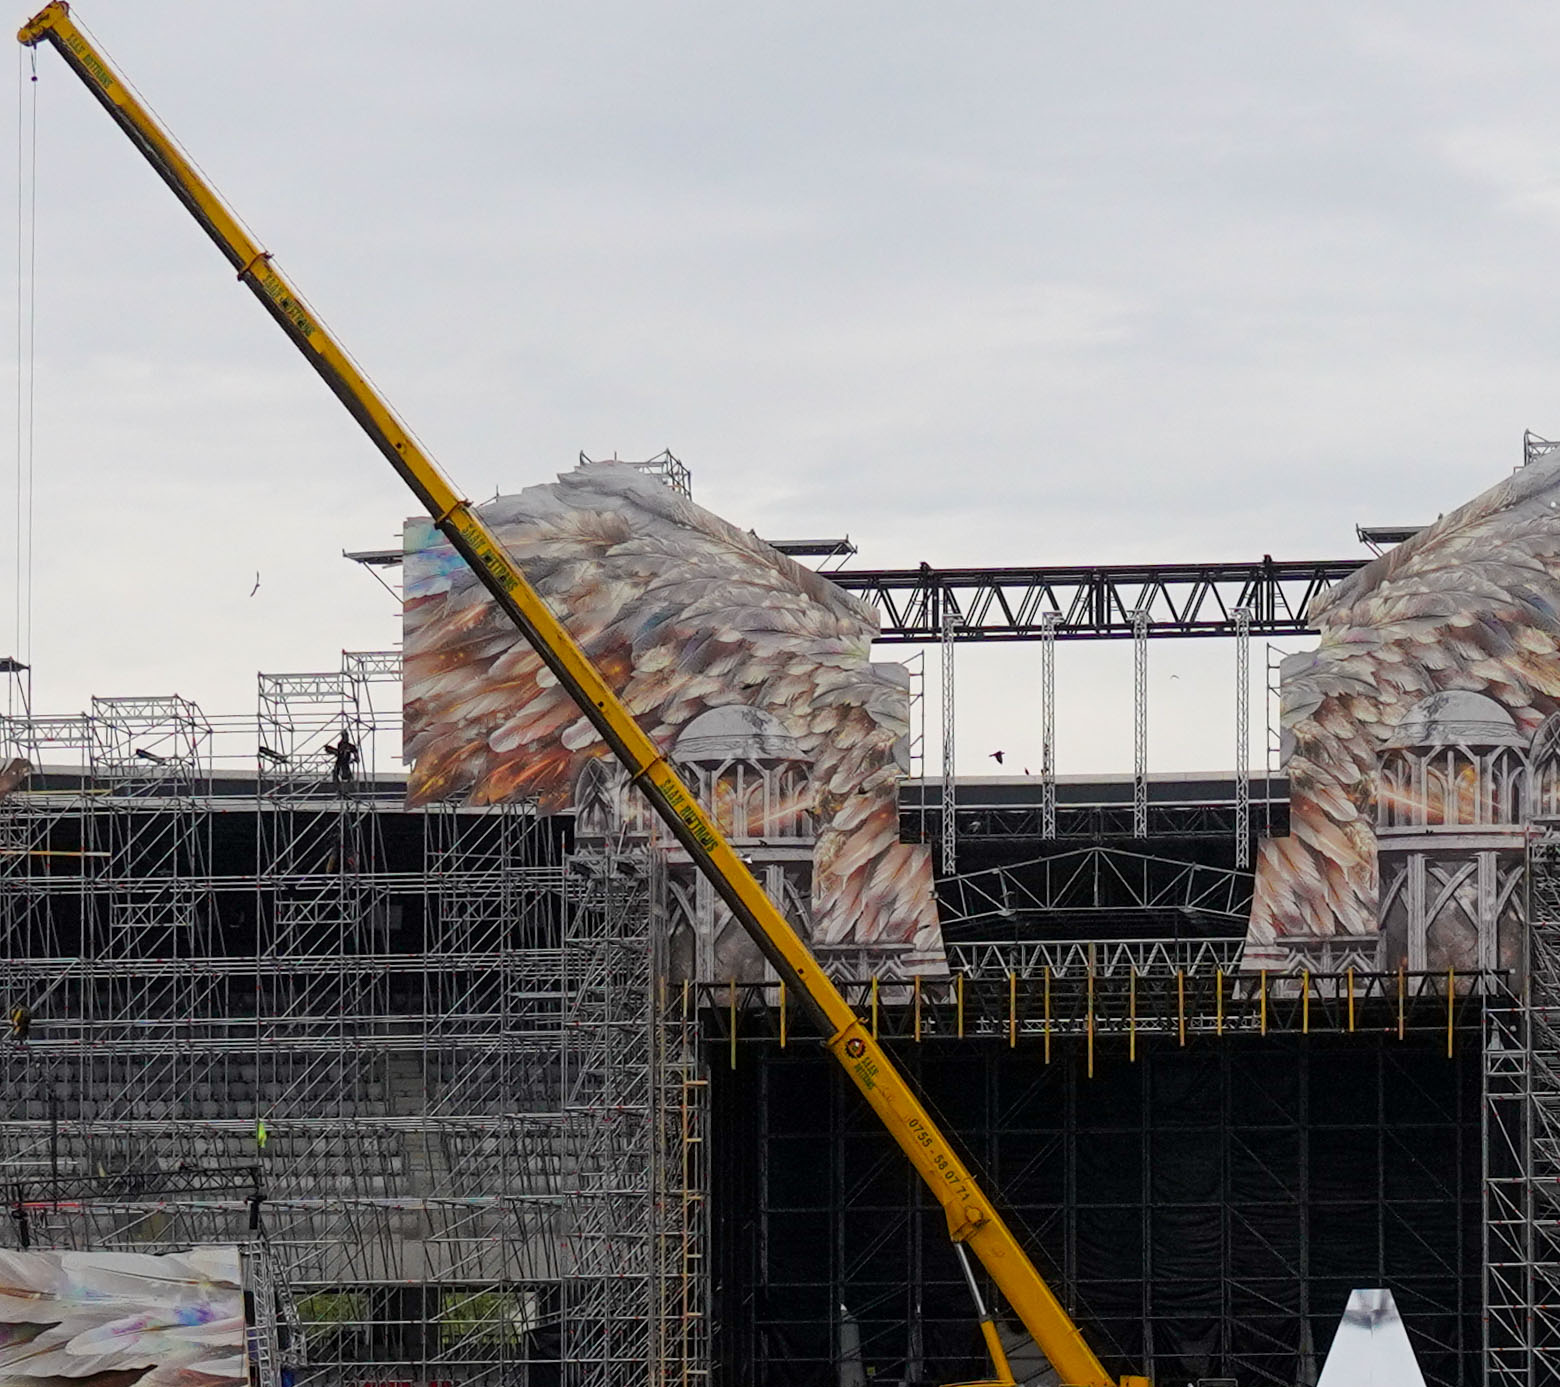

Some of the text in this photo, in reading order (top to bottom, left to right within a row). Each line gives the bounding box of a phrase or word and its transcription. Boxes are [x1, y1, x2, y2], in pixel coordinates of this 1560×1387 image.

[909, 1119, 932, 1147] 0755
[934, 1154, 948, 1170] 58
[945, 1171, 960, 1184] 07
